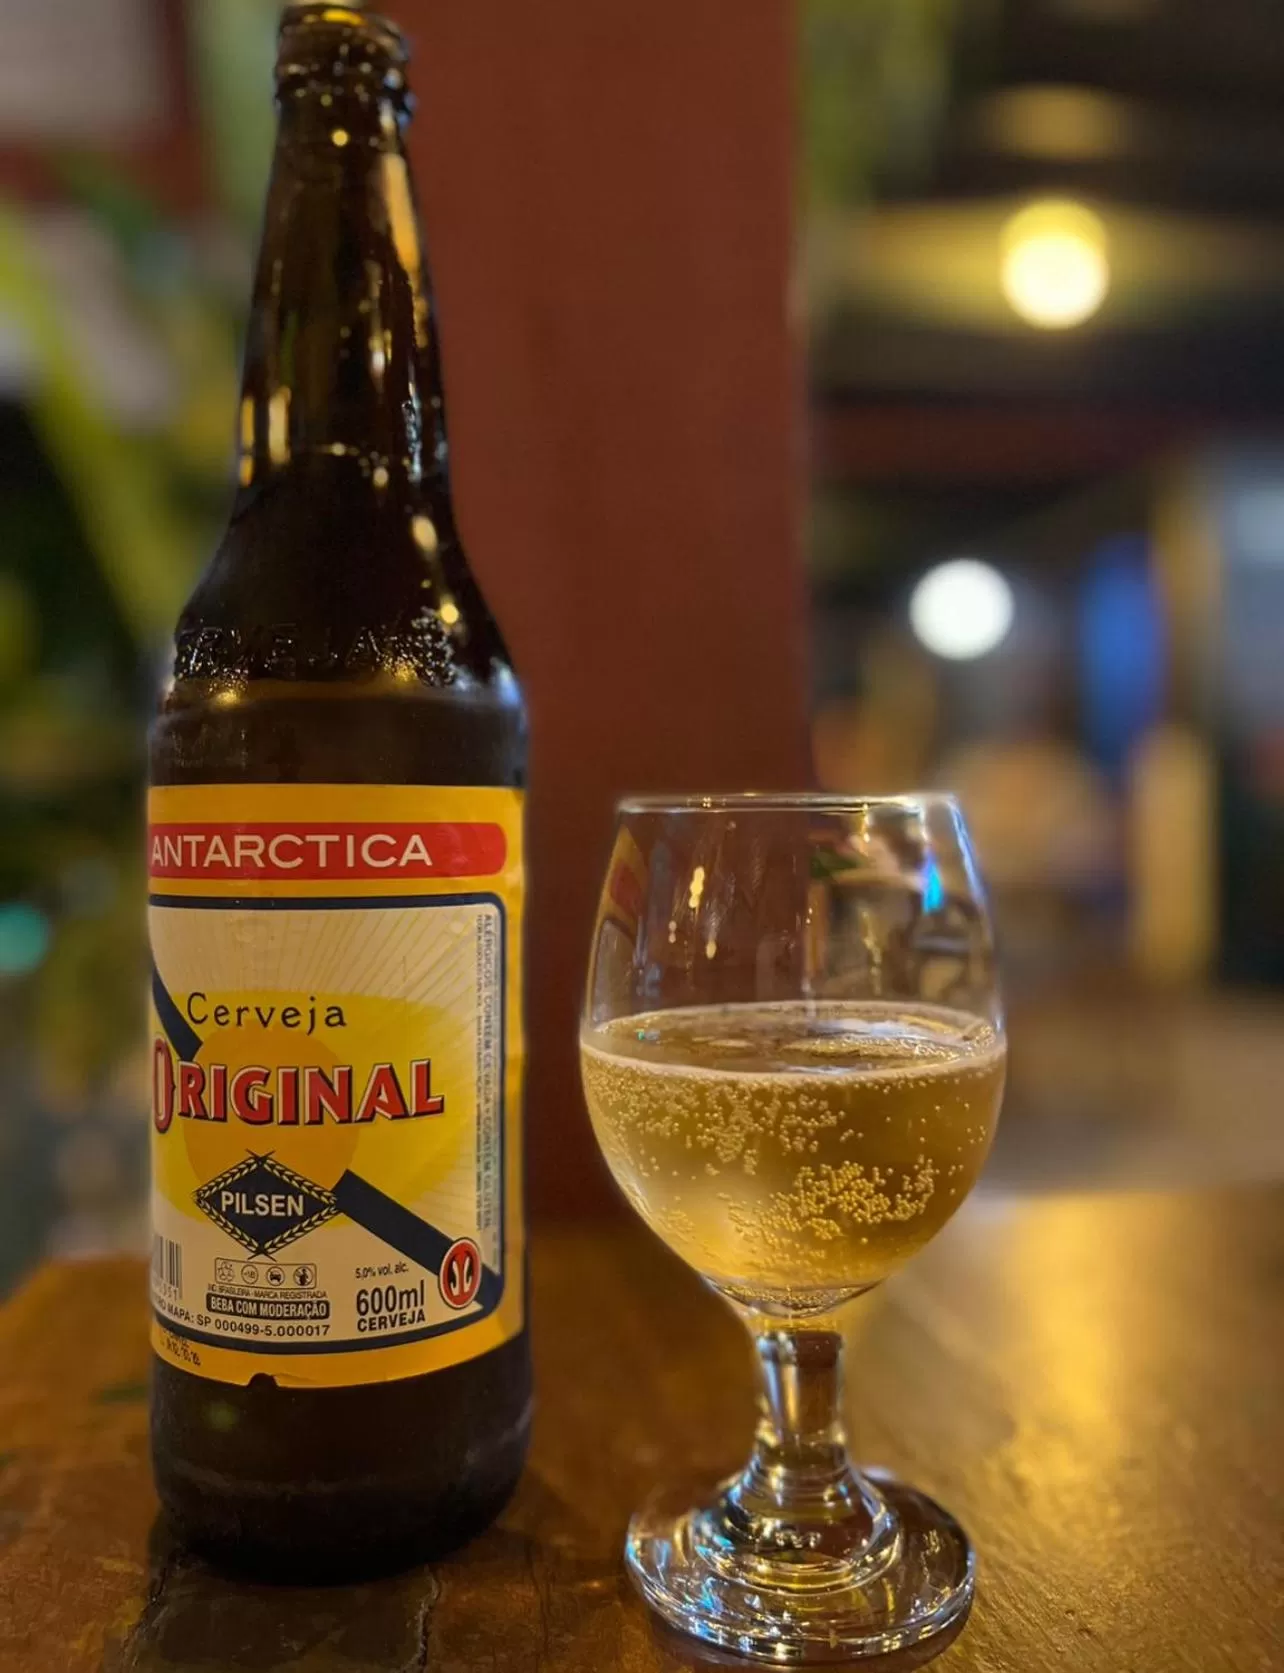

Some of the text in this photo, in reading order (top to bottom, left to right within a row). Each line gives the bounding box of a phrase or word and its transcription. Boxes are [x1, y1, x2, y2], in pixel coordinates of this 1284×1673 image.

[151, 834, 433, 868] ANTARCTICA
[187, 991, 347, 1035] Cerveja
[154, 1035, 444, 1133] ORIGINAL
[221, 1191, 304, 1218] PILSEN
[211, 1296, 327, 1319] BEBA COM MODERAÇÃO
[254, 1290, 278, 1298] MARCA
[280, 1290, 327, 1300] REGISTRADA
[356, 1279, 424, 1316] 600ml
[167, 1303, 194, 1323] MAPA:
[196, 1314, 212, 1328] SP
[214, 1319, 331, 1337] 000499-5.000017
[357, 1309, 426, 1332] CERVEJA
